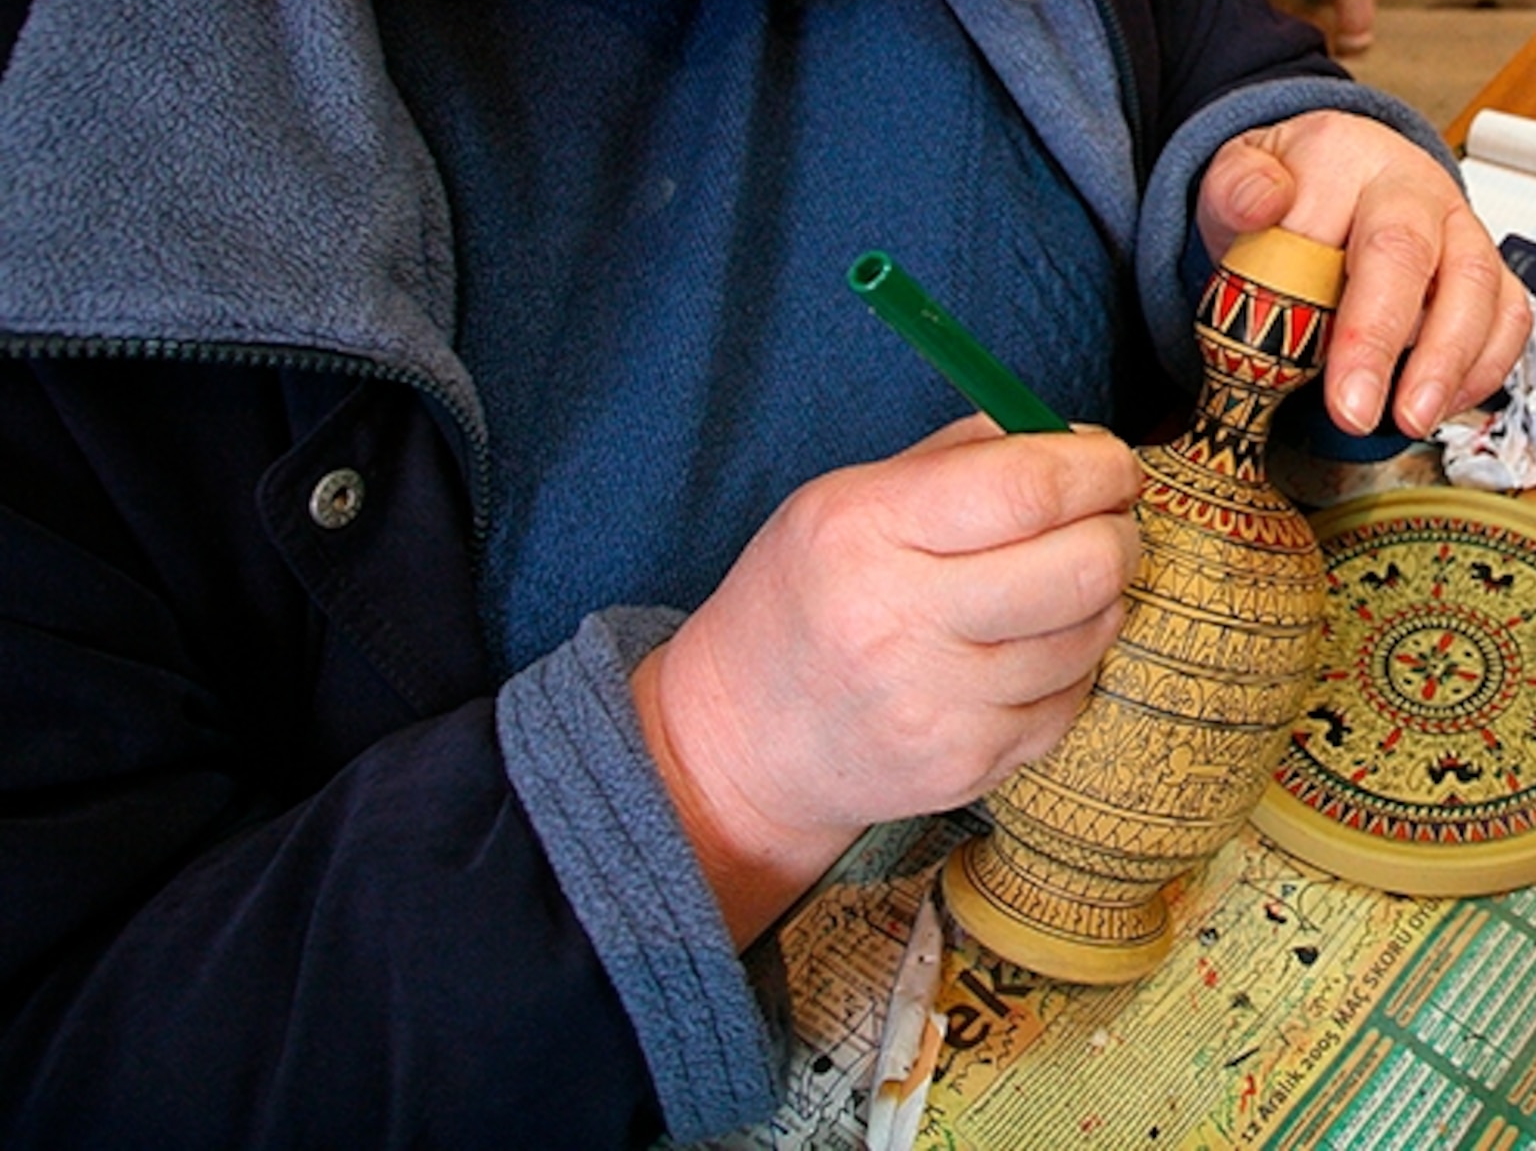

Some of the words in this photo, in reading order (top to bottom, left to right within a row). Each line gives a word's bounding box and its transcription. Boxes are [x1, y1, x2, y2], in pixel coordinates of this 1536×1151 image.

[1257, 1068, 1305, 1123] Aralık
[1300, 1030, 1341, 1071] 2005
[1331, 986, 1370, 1030] MAÇ
[1362, 930, 1412, 987] SKORU
